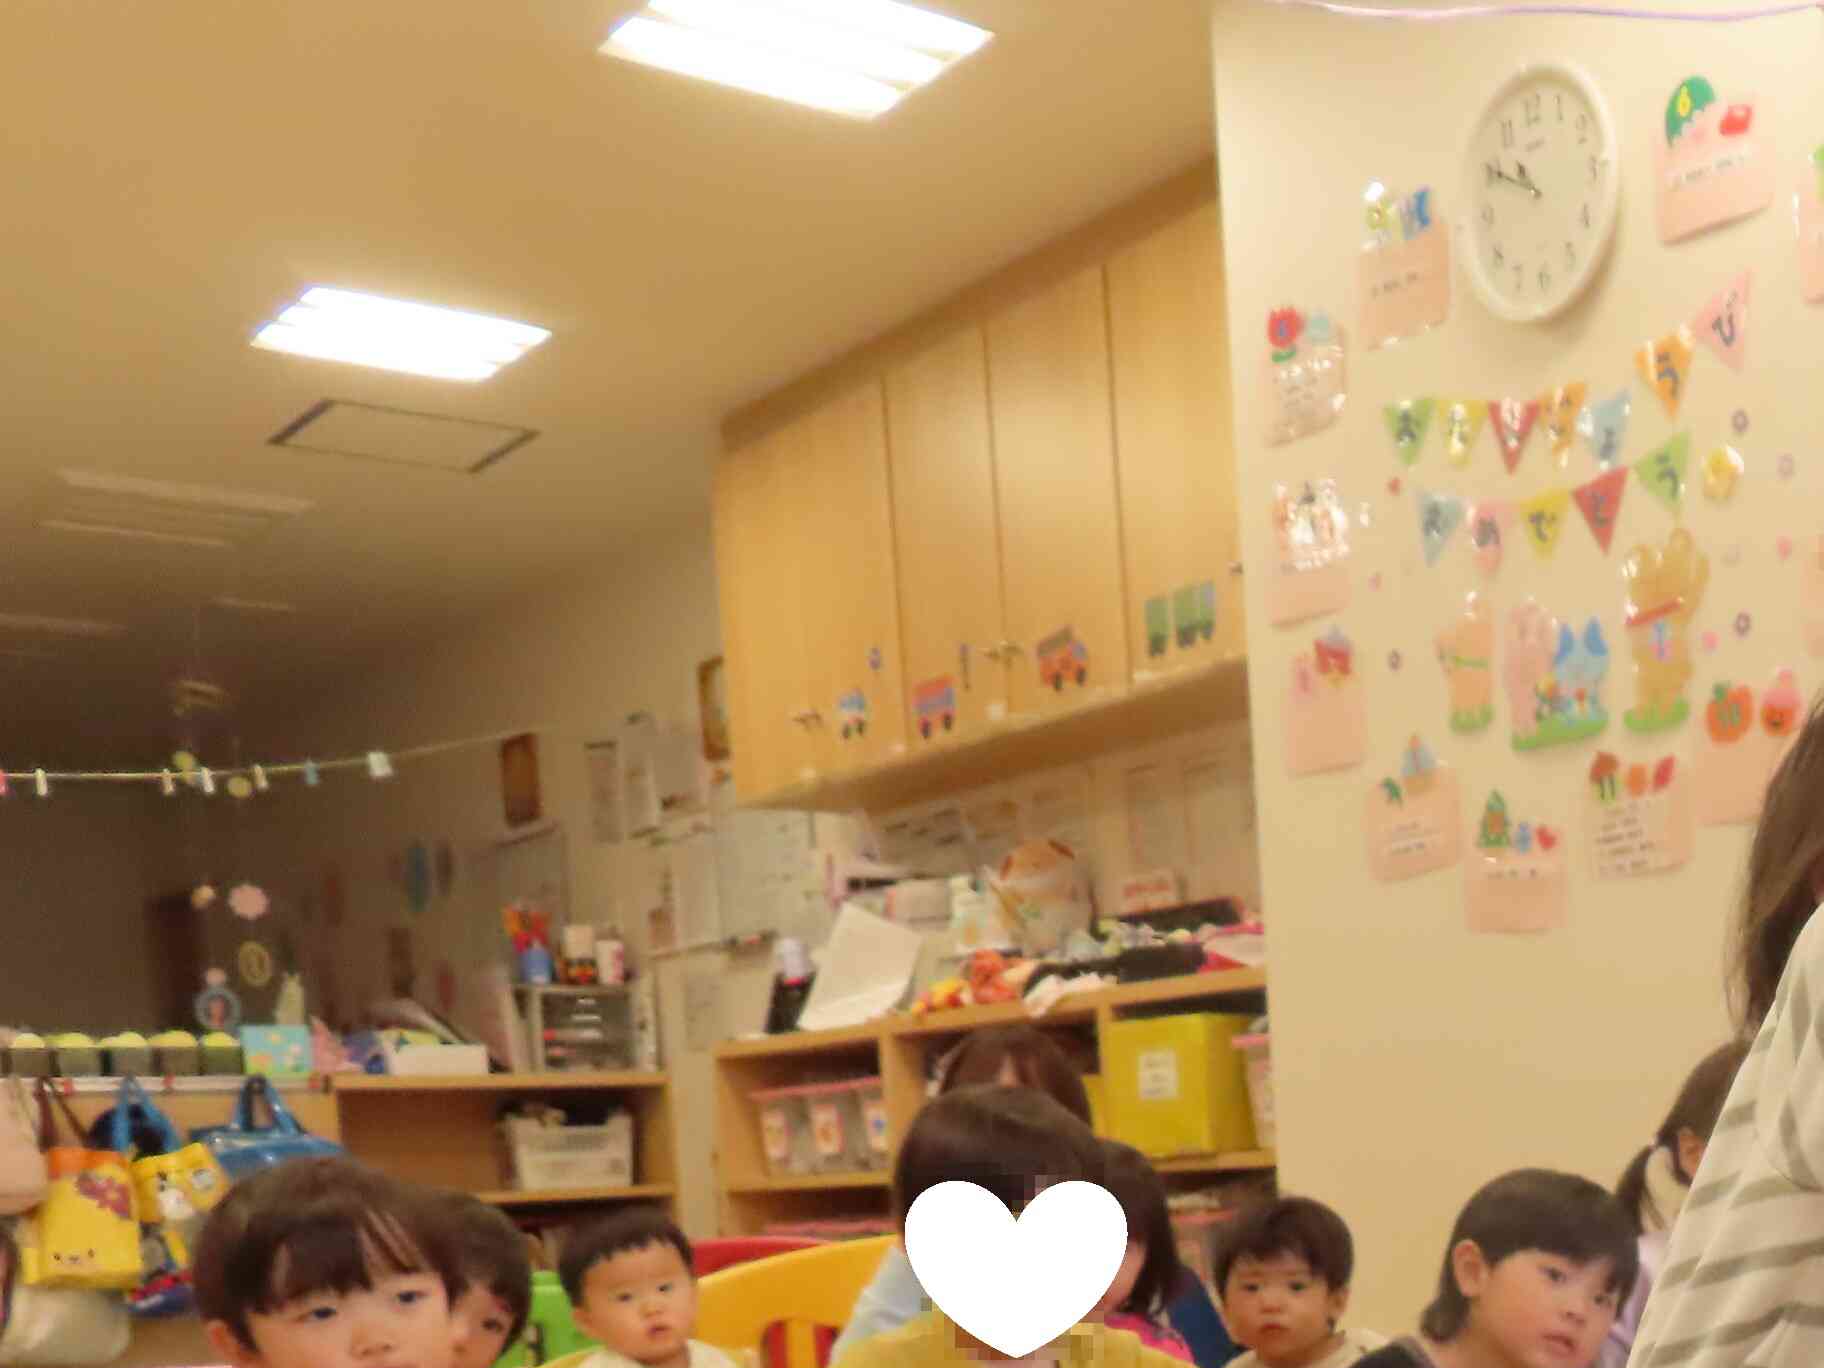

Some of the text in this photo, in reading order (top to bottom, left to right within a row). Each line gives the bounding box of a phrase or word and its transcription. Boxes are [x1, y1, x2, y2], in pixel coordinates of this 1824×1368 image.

[1421, 452, 1688, 548] おめでとう
